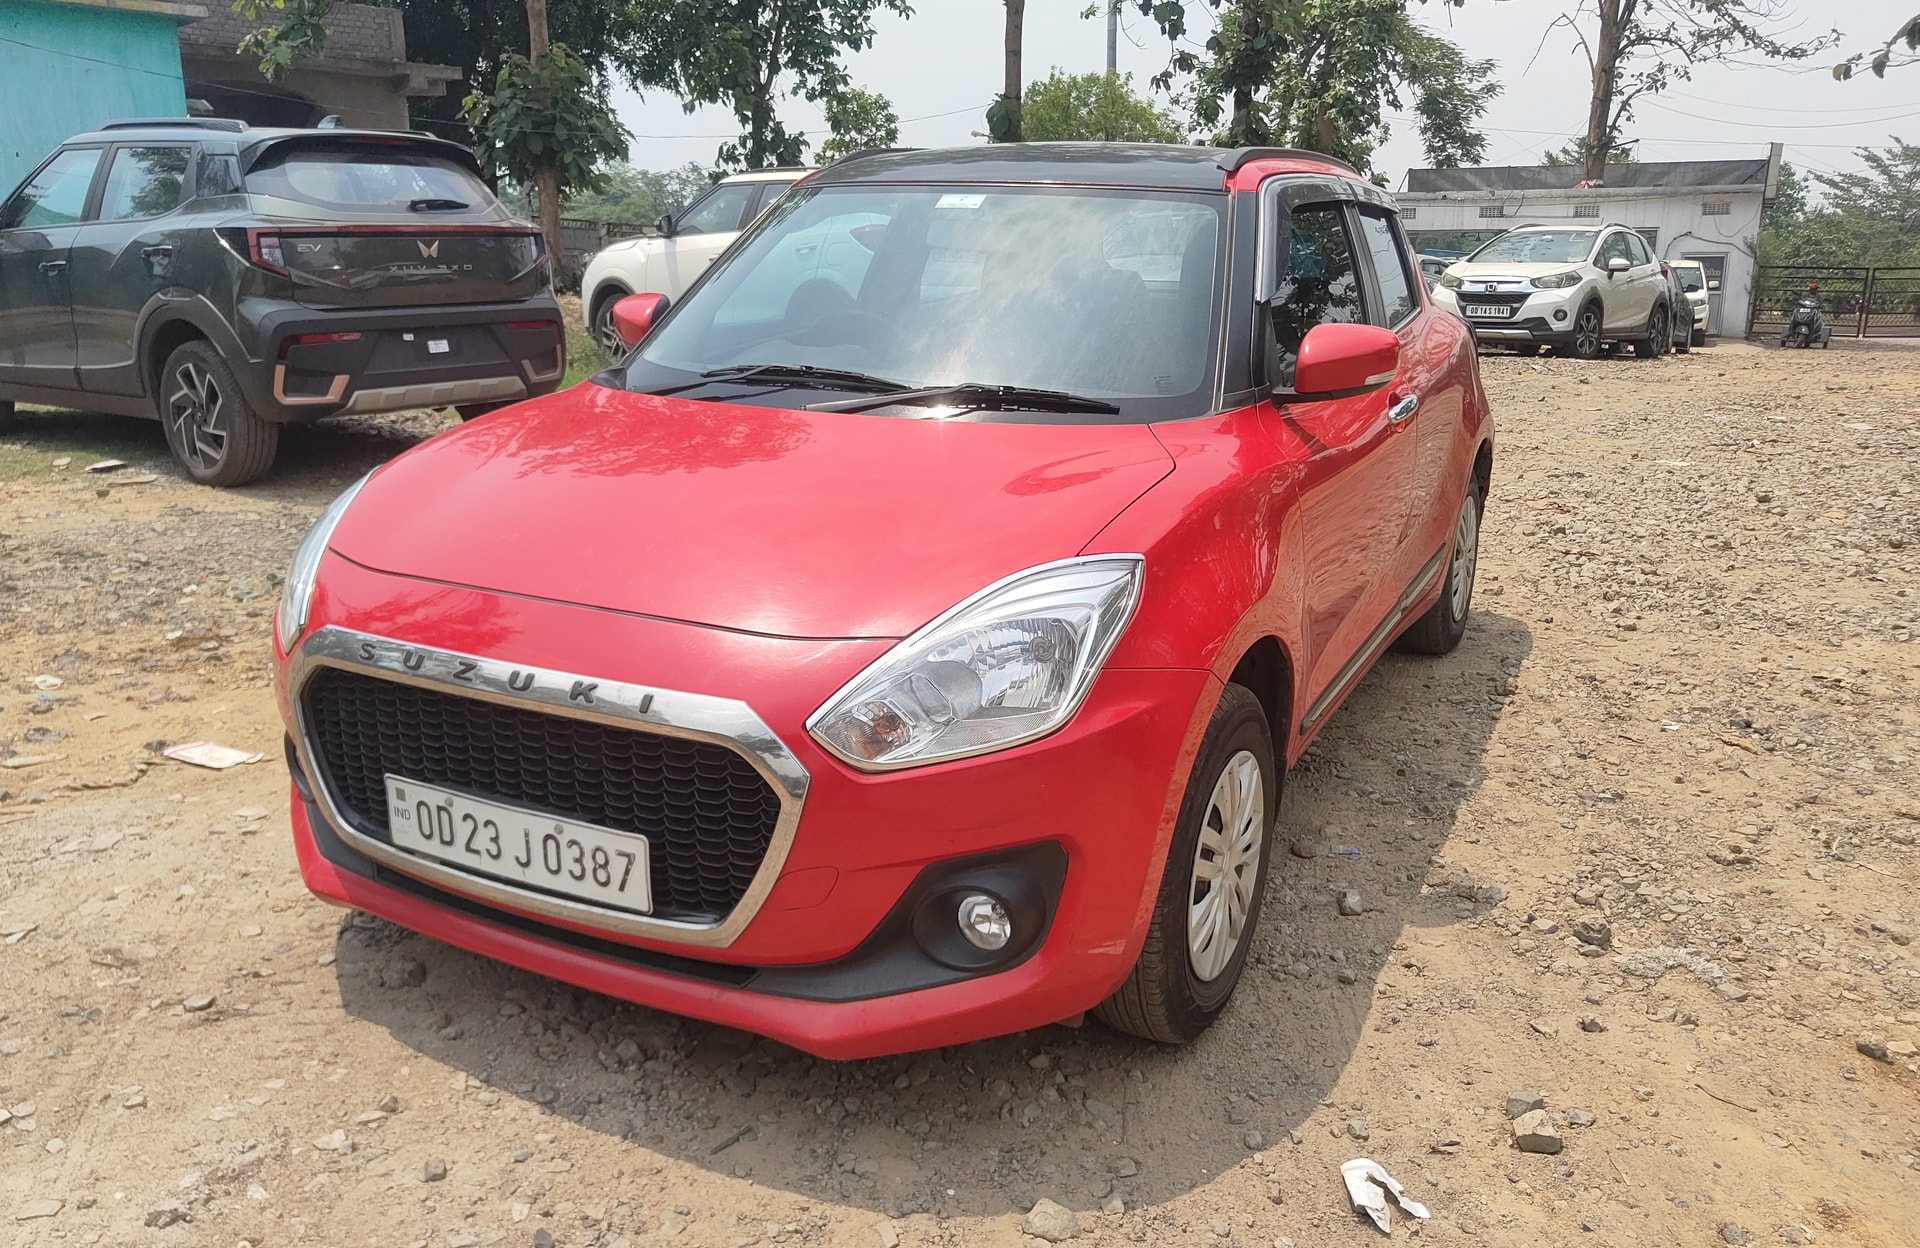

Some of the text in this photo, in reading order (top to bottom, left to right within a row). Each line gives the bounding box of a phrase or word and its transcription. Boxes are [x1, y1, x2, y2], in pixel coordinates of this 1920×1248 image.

[297, 243, 321, 252] EV
[388, 264, 427, 273] XUV
[359, 642, 655, 715] SUZUKI
[394, 805, 411, 821] IND
